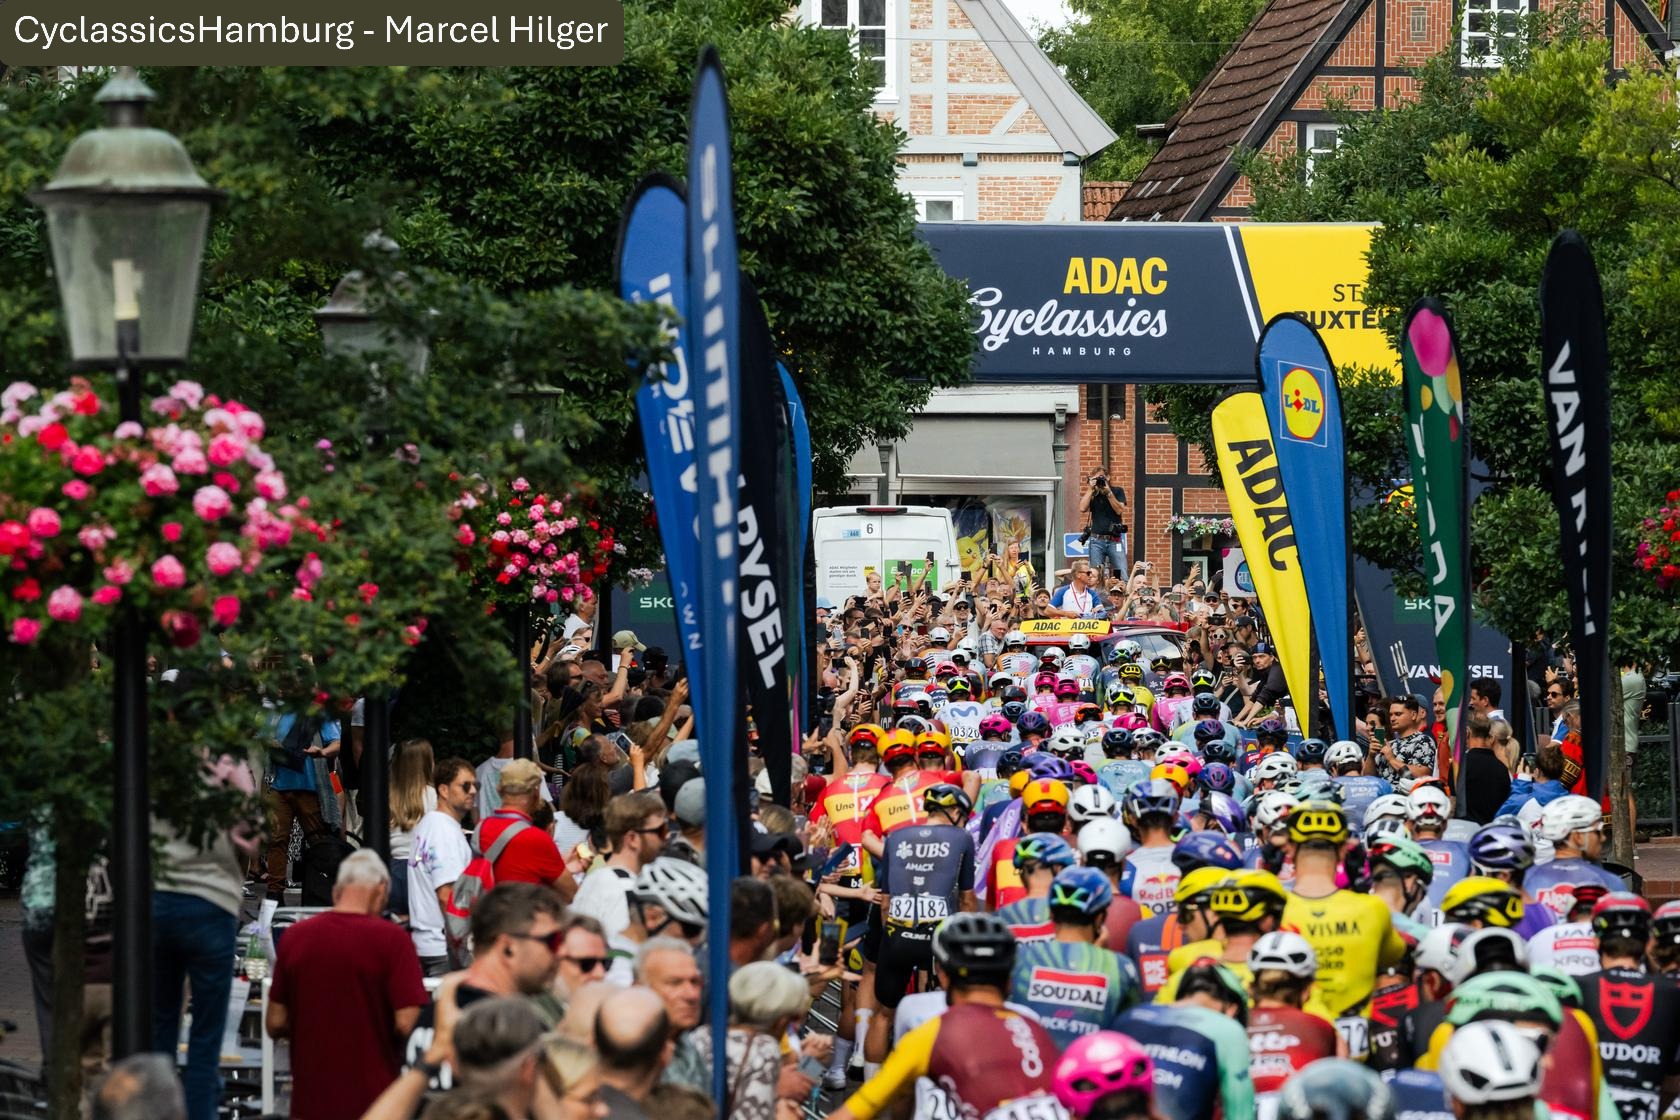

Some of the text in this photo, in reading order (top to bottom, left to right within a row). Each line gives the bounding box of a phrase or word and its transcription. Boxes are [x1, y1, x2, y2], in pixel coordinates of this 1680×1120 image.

[1064, 257, 1168, 295] ADAC
[1033, 347, 1132, 356] HAMBURG
[1548, 340, 1588, 477] VAN
[1227, 438, 1299, 572] ADAC
[866, 523, 873, 534] 6
[1033, 621, 1099, 631] ADAC ADAC
[835, 803, 855, 812] Uno
[888, 805, 910, 816] Uno
[915, 842, 950, 857] UBS
[919, 900, 946, 918] 182
[1307, 922, 1360, 936] VISMA
[1031, 984, 1104, 1006] SOUDAL
